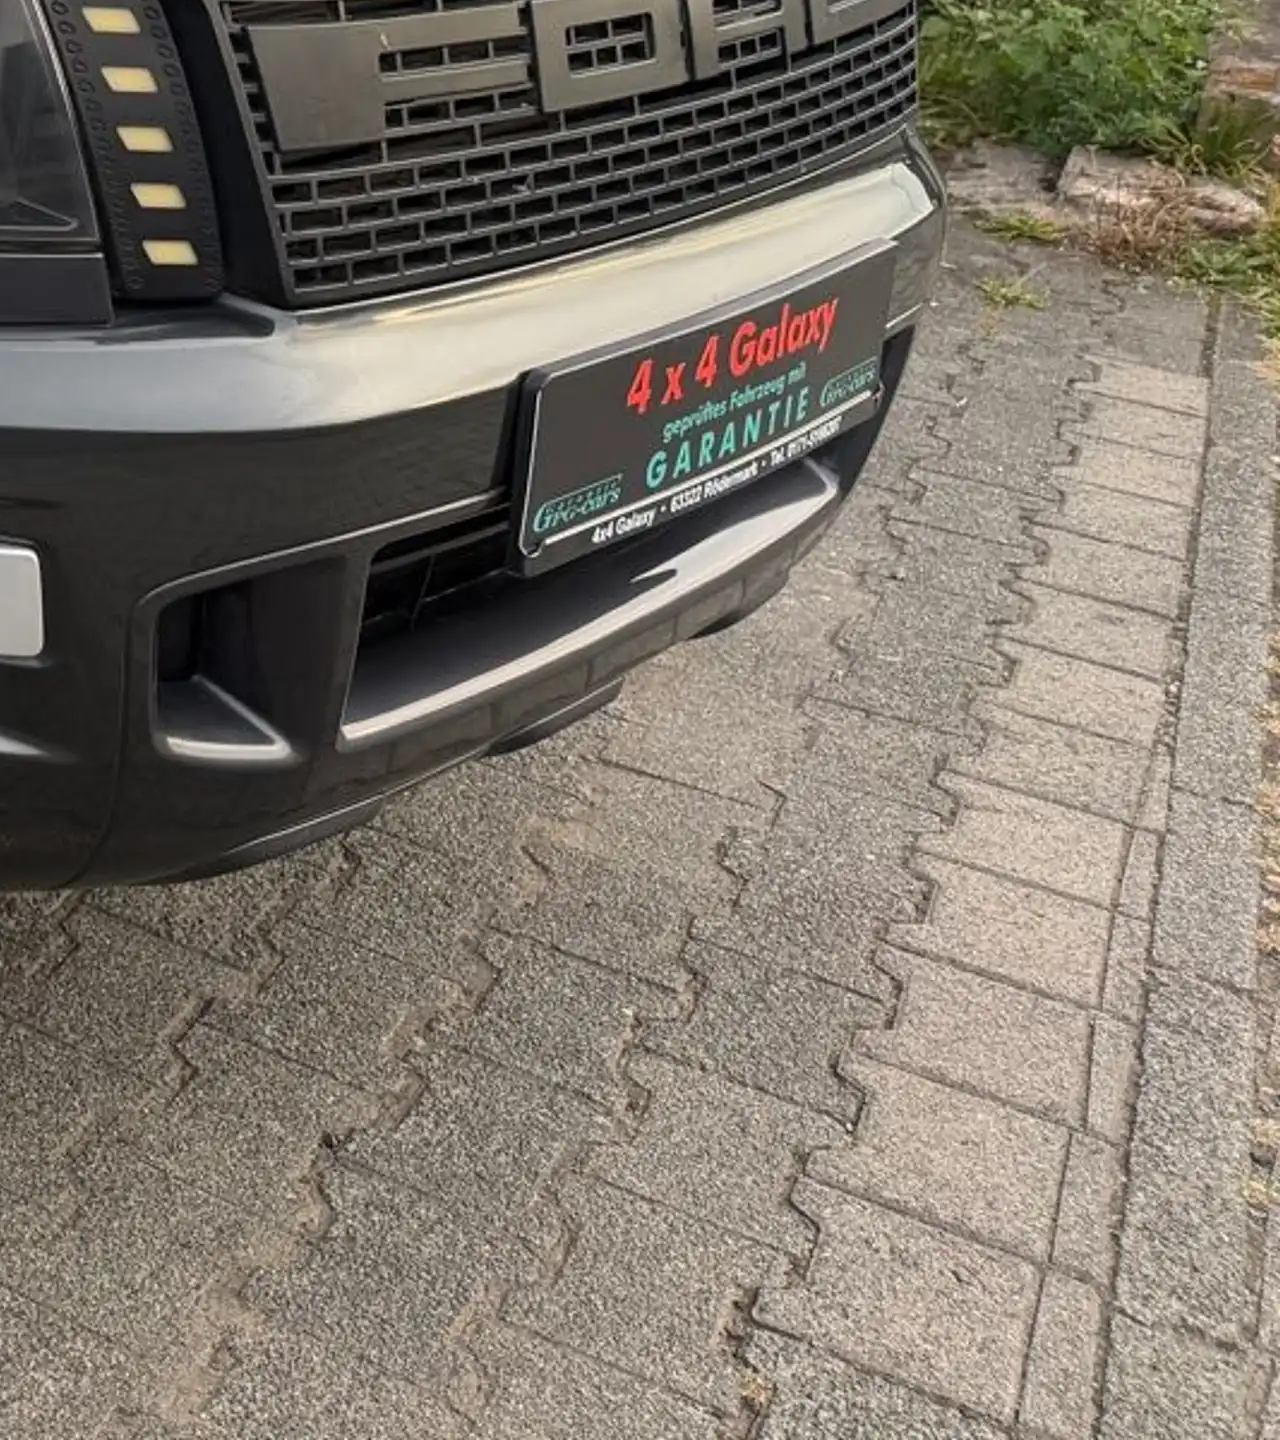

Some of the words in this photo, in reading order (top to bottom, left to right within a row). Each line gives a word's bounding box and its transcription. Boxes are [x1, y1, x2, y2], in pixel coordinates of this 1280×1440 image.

[626, 359, 654, 415] 4
[661, 362, 687, 405] x
[694, 335, 719, 388] 4
[729, 298, 839, 376] Galaxy
[646, 386, 810, 488] GARANTIE
[591, 520, 614, 544] 4x4
[616, 508, 658, 535] Galaxy
